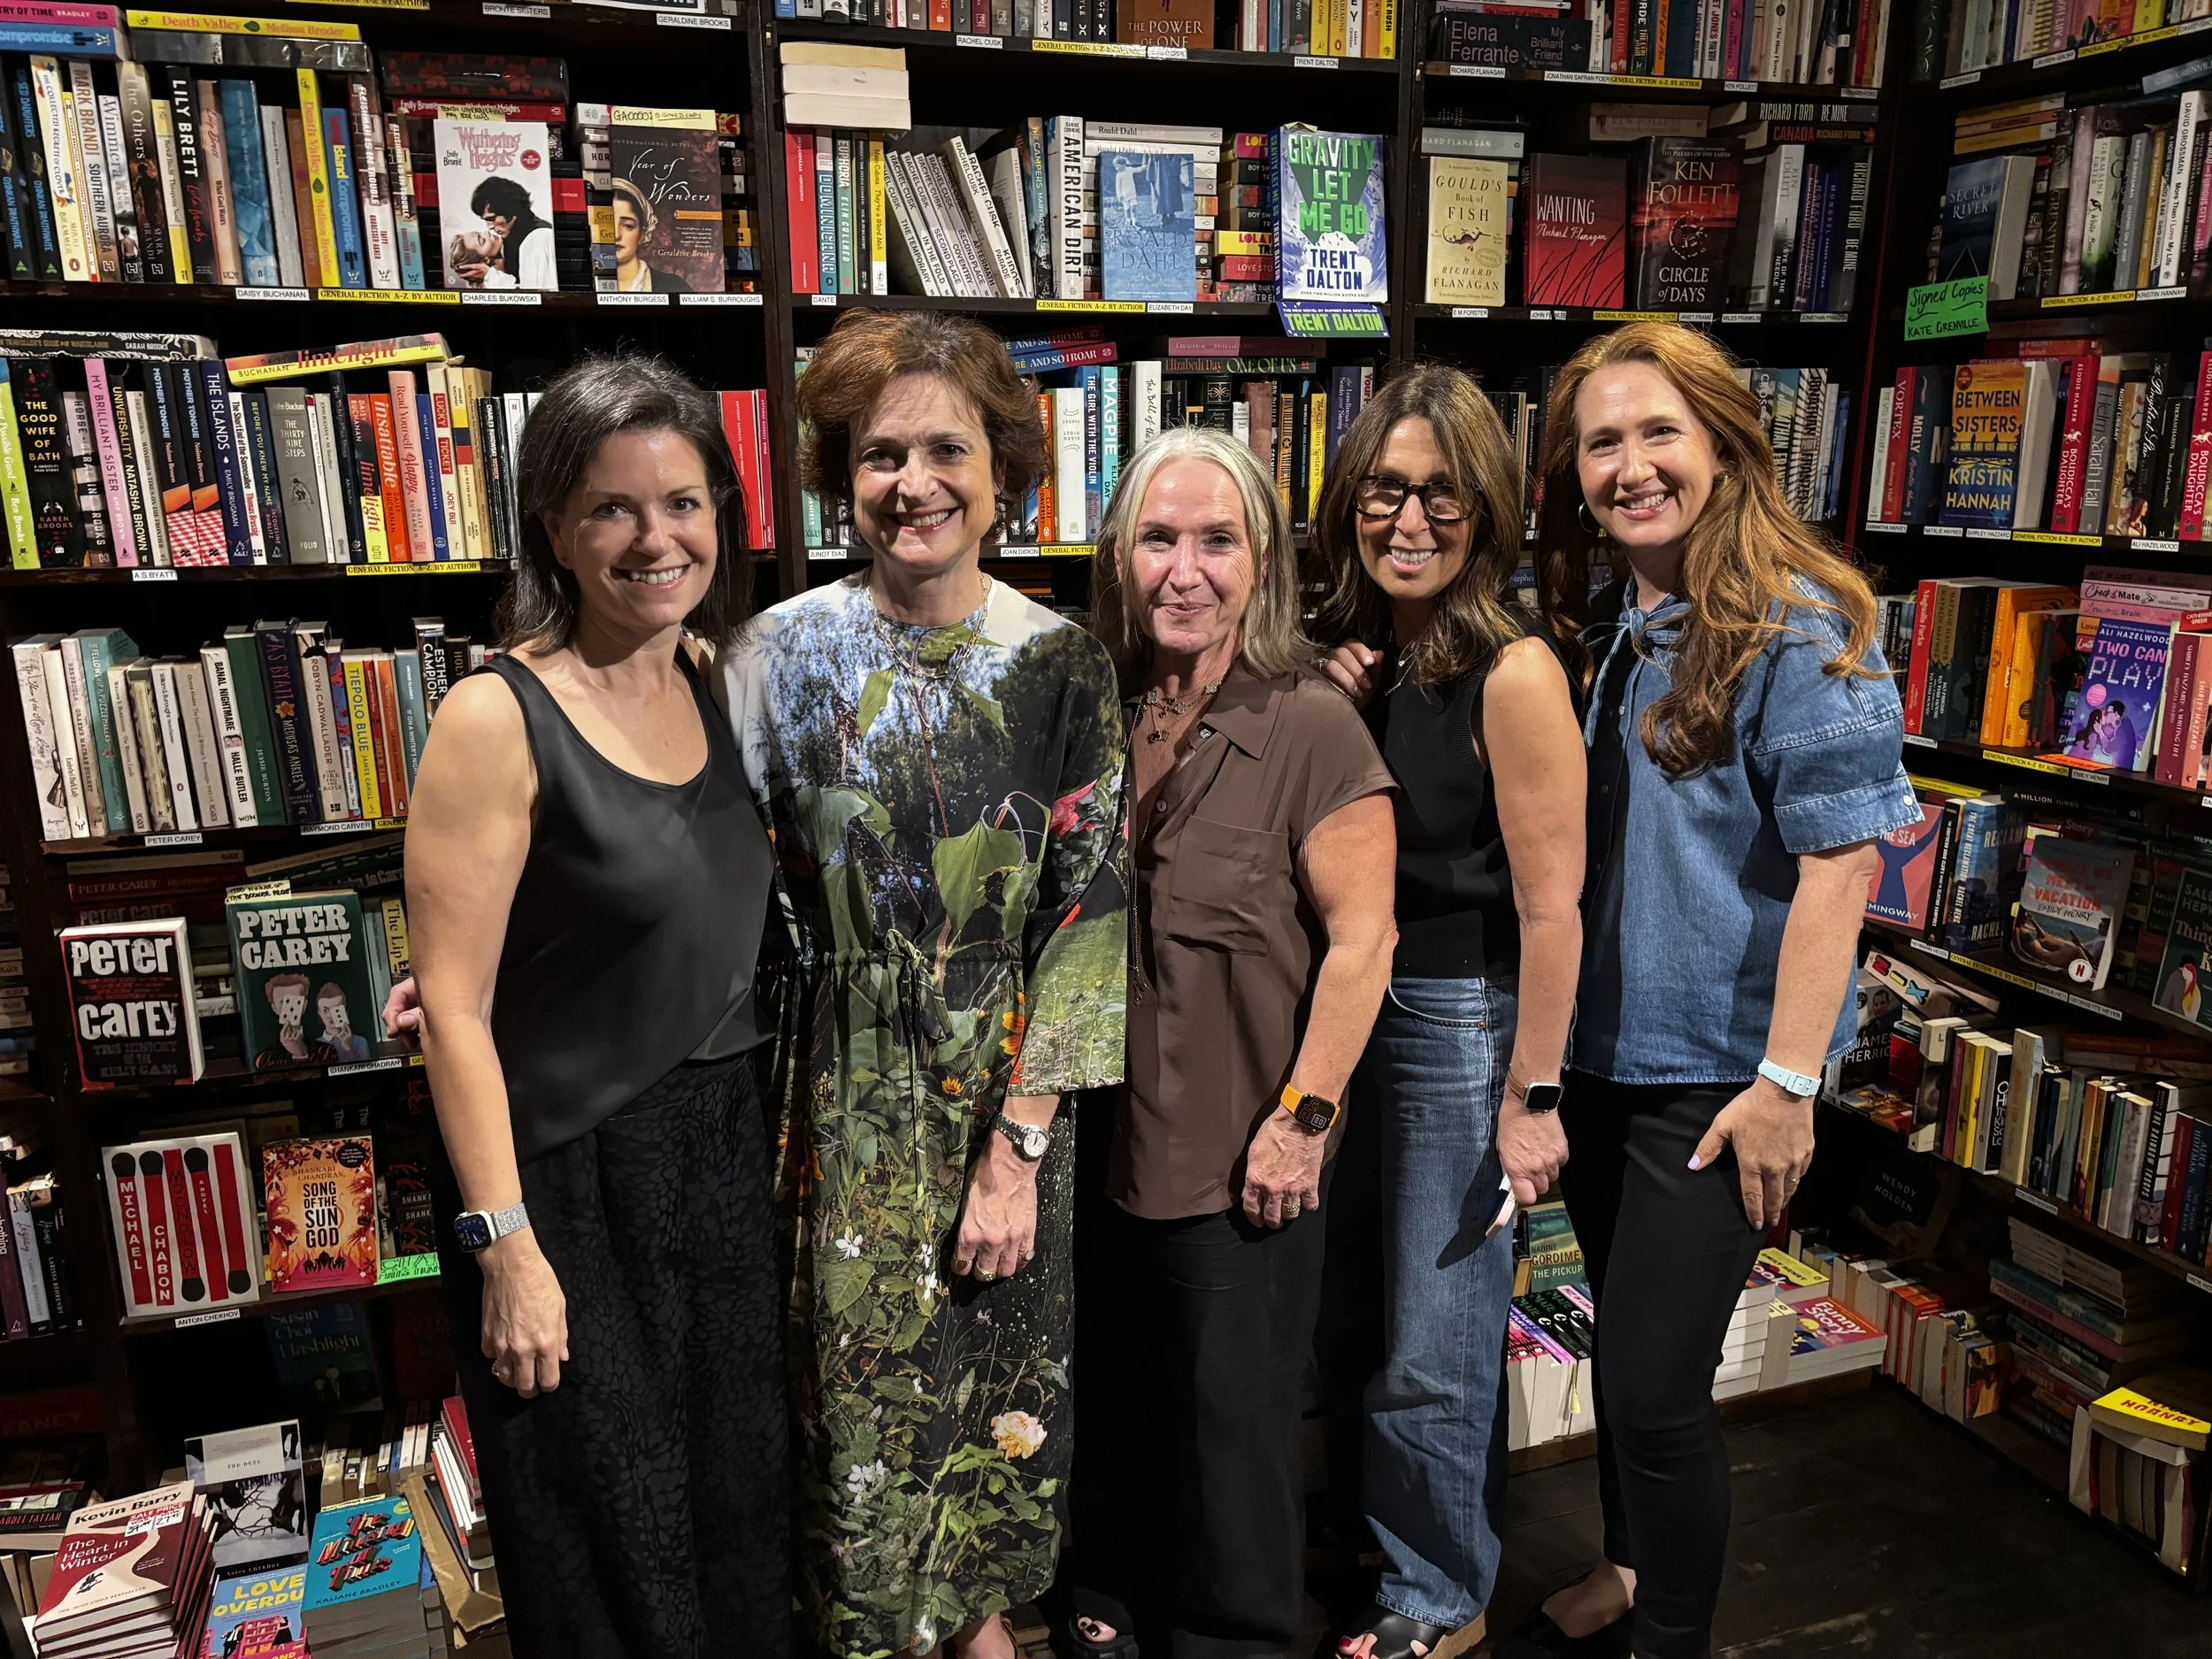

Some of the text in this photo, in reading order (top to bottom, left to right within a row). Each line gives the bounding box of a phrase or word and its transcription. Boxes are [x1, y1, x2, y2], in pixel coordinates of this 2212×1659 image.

[484, 4, 549, 16] BRONTE SISTERS
[162, 17, 241, 30] Death Valley
[658, 15, 729, 27] GERALDINE BROOKS
[1128, 20, 1202, 35] THE POWER
[1450, 21, 1498, 42] Elena
[1550, 27, 1564, 40] My
[958, 37, 983, 46] RACHEL
[1152, 35, 1188, 48] ONE
[1531, 36, 1564, 50] Brilliant
[1450, 42, 1519, 65] Ferrante
[1534, 48, 1563, 60] Friend
[172, 80, 198, 177] LILY BRETT
[453, 126, 521, 154] Wuthering
[446, 150, 459, 159] Emily
[469, 147, 517, 173] Heights
[1287, 135, 1376, 170] GRAVITY
[629, 150, 684, 180] Year of
[1674, 161, 1715, 180] KEN
[648, 181, 710, 204] Wonders
[1313, 171, 1352, 202] LET
[1436, 176, 1502, 193] GOULD'S
[1649, 182, 1735, 205] FOLLETT
[1064, 136, 1081, 277] AMERICAN DIRT
[1455, 193, 1484, 204] Book of
[1298, 201, 1367, 234] ME GO
[1448, 206, 1488, 221] FISH
[1537, 195, 1594, 226] WANTING
[1310, 249, 1356, 270] TRENT
[1307, 270, 1363, 289] DALTON
[1441, 267, 1492, 277] RICHARD
[1659, 267, 1709, 284] CIRCLE
[1432, 279, 1499, 290] FLANAGAN
[2160, 288, 2185, 297] HANNAH
[237, 290, 306, 299] DAISY BUCHANAN
[320, 289, 357, 299] GENERAL
[358, 291, 391, 300] FICTION
[394, 292, 409, 301] A-Z
[424, 293, 457, 302] AUTHOR
[463, 294, 537, 303] CHARLES BUKOWSKI
[599, 296, 666, 304] ANTHONY BURGESS
[718, 296, 760, 304] BURROUGHS
[1658, 287, 1705, 303] of DAYS
[1910, 282, 1984, 313] Signed Copies
[1285, 313, 1384, 332] TRENT DALTON
[1908, 323, 1932, 337] KATE
[297, 342, 397, 370] limelight
[1030, 356, 1048, 368] AND
[1050, 355, 1065, 365] SO
[1070, 349, 1097, 363] ROAR
[238, 365, 290, 377] BUCHANAN
[1955, 390, 2020, 408] BETWEEN
[19, 414, 58, 423] GOOD
[1103, 376, 1118, 457] MAGPIE
[1955, 416, 2017, 433] SISTERS
[25, 426, 56, 435] WIFE
[35, 439, 50, 448] OF
[373, 401, 396, 488] insatiable
[1948, 468, 2013, 487] KRISTIN
[1947, 492, 2010, 511] HANNAH
[2118, 590, 2140, 600] Mate
[2116, 630, 2170, 644] HAZELWOOD
[2098, 641, 2167, 664] TWO CAN
[2088, 656, 2162, 690] PLAY
[350, 668, 368, 752] TIEPOLO BLUE
[302, 821, 371, 833] RAYMOND CARVER
[236, 903, 349, 938] PETER
[241, 933, 351, 970] CAREY
[303, 1181, 337, 1198] SONG
[303, 1195, 337, 1209] OF THE
[120, 1181, 143, 1270] MICHAEL
[304, 1210, 338, 1229] SUN
[305, 1228, 340, 1248] GOD
[1532, 1244, 1557, 1253] NADINE
[154, 1225, 170, 1301] CHABON
[1532, 1265, 1583, 1279] THE PICKUP
[178, 1310, 239, 1325] ANTON CHEKHOV
[1805, 1308, 1850, 1334] Story
[1815, 1302, 1867, 1334] Funny
[2120, 1399, 2201, 1426] HORNBY
[74, 1507, 126, 1525] Kevin
[131, 1491, 182, 1510] Barry
[131, 1502, 184, 1520] SALE PRICE
[62, 1540, 128, 1562] Heart in
[66, 1539, 95, 1552] The
[60, 1552, 117, 1571] Winter
[234, 1572, 305, 1600] LOVE
[316, 1579, 402, 1604] KALIANE BRADLEY
[213, 1588, 303, 1617] OVERDU
